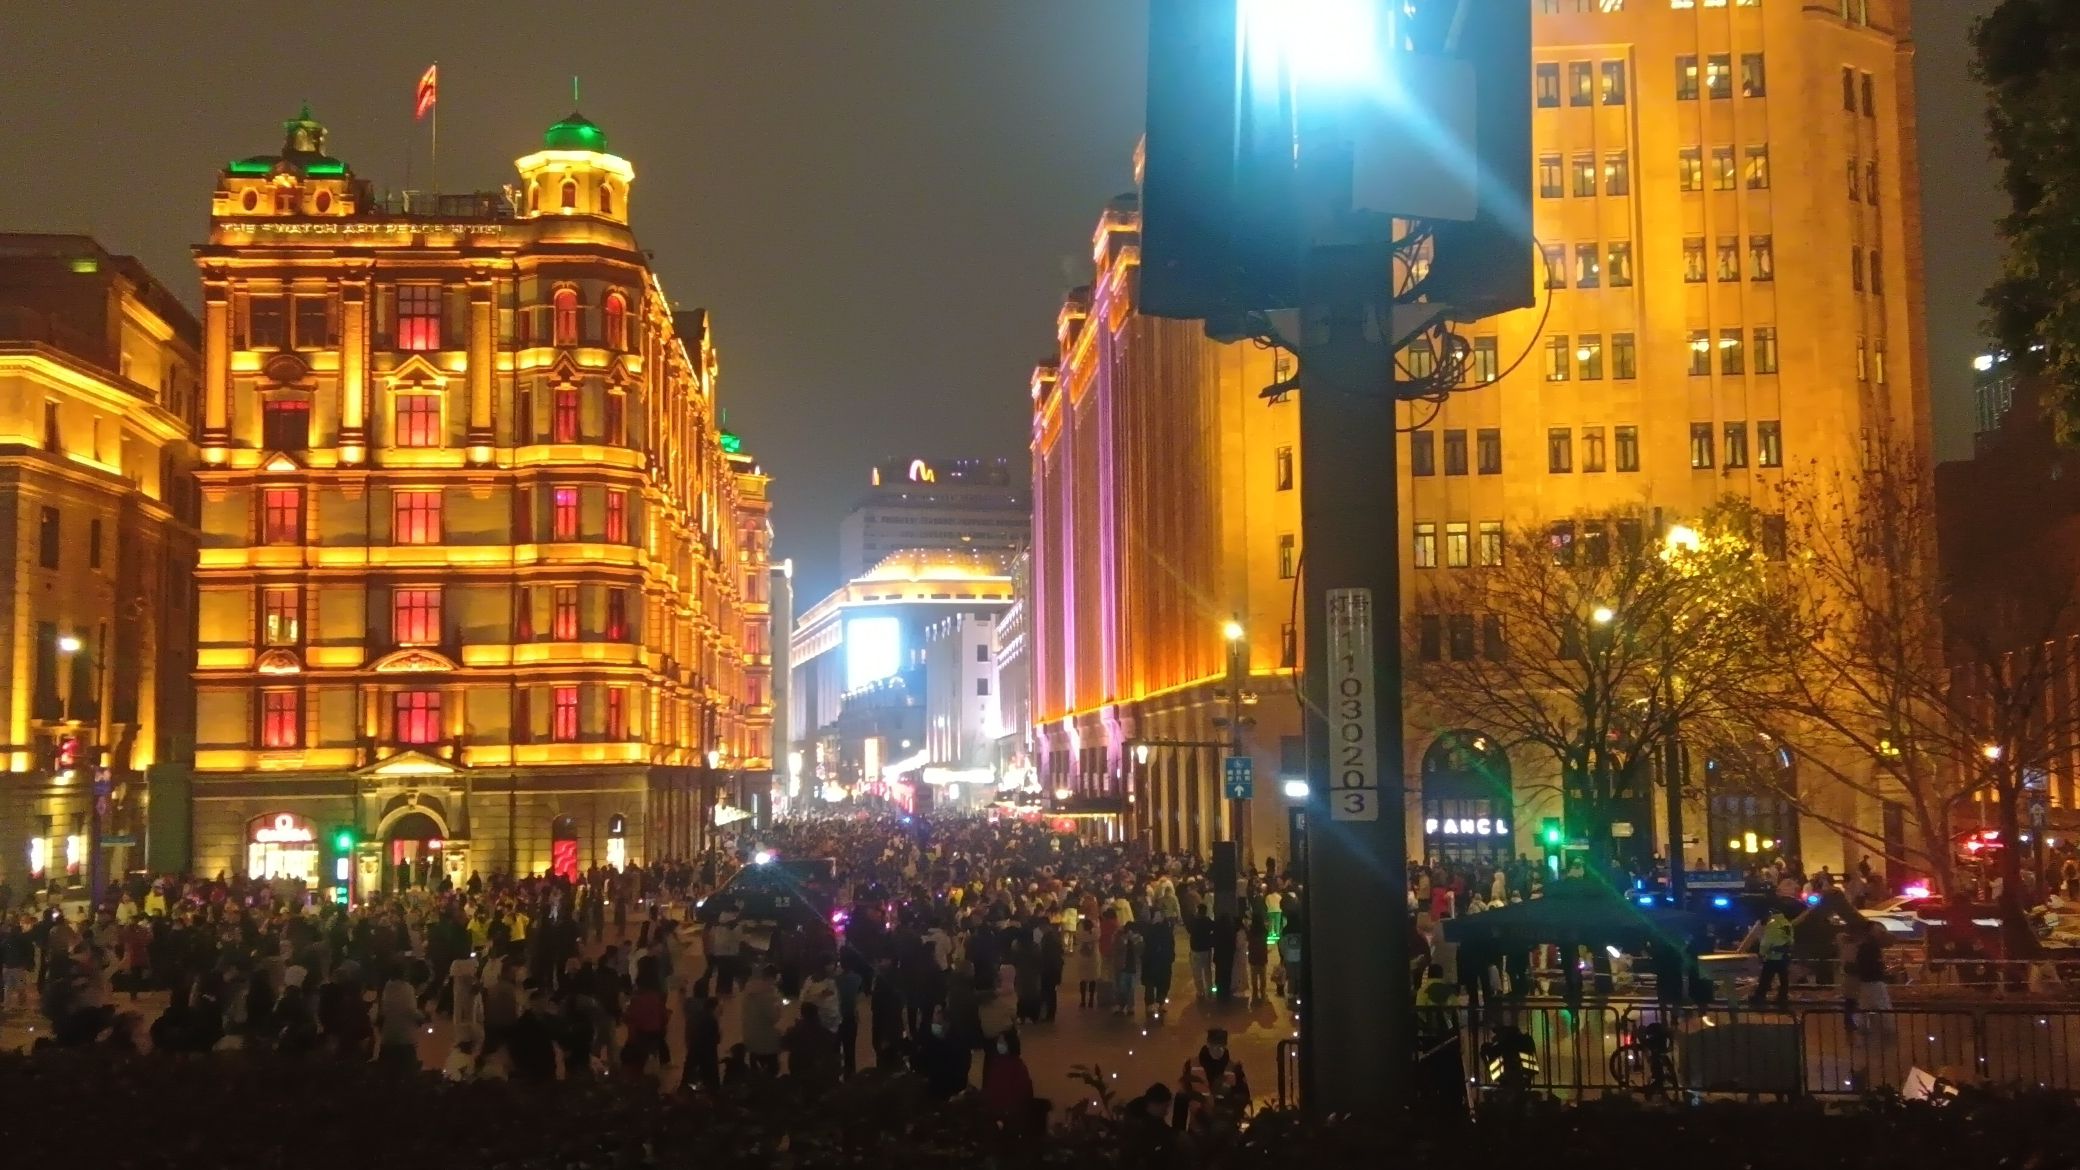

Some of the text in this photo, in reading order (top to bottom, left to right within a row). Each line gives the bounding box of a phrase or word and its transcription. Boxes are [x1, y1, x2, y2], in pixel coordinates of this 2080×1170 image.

[220, 223, 256, 234] THE
[343, 223, 380, 234] ART
[1329, 594, 1370, 613] 灯号
[1340, 631, 1366, 814] 11030203
[1426, 818, 1509, 835] FANCL
